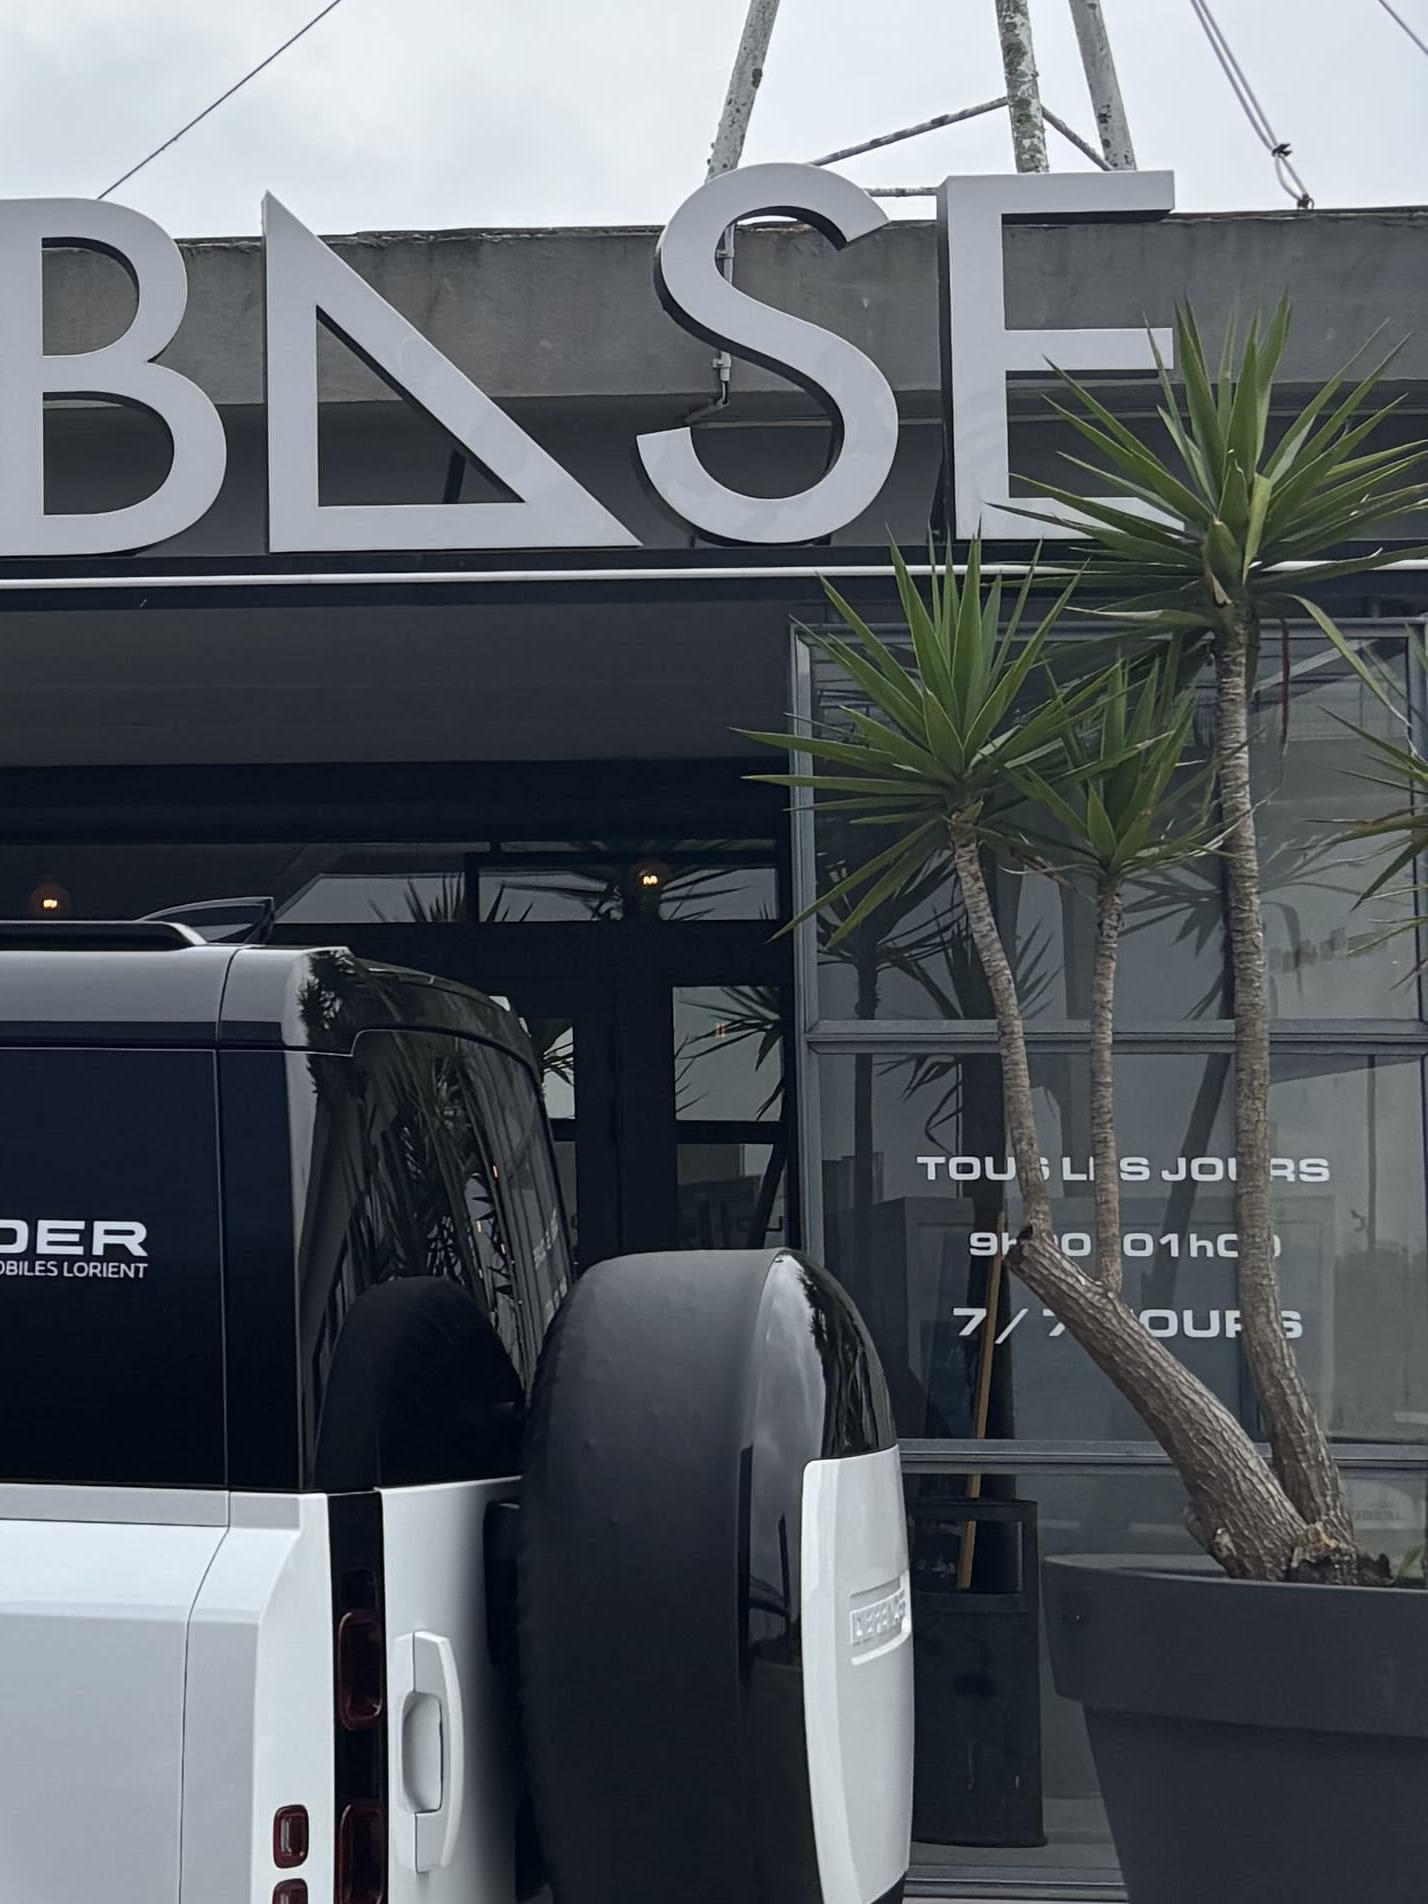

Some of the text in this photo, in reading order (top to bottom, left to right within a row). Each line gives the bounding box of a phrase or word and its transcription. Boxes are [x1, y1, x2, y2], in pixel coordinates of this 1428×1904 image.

[1062, 1156, 1151, 1182] LS
[1161, 1156, 1330, 1183] JORS
[1123, 1232, 1282, 1258] 01h0
[62, 1260, 149, 1279] LORIENT
